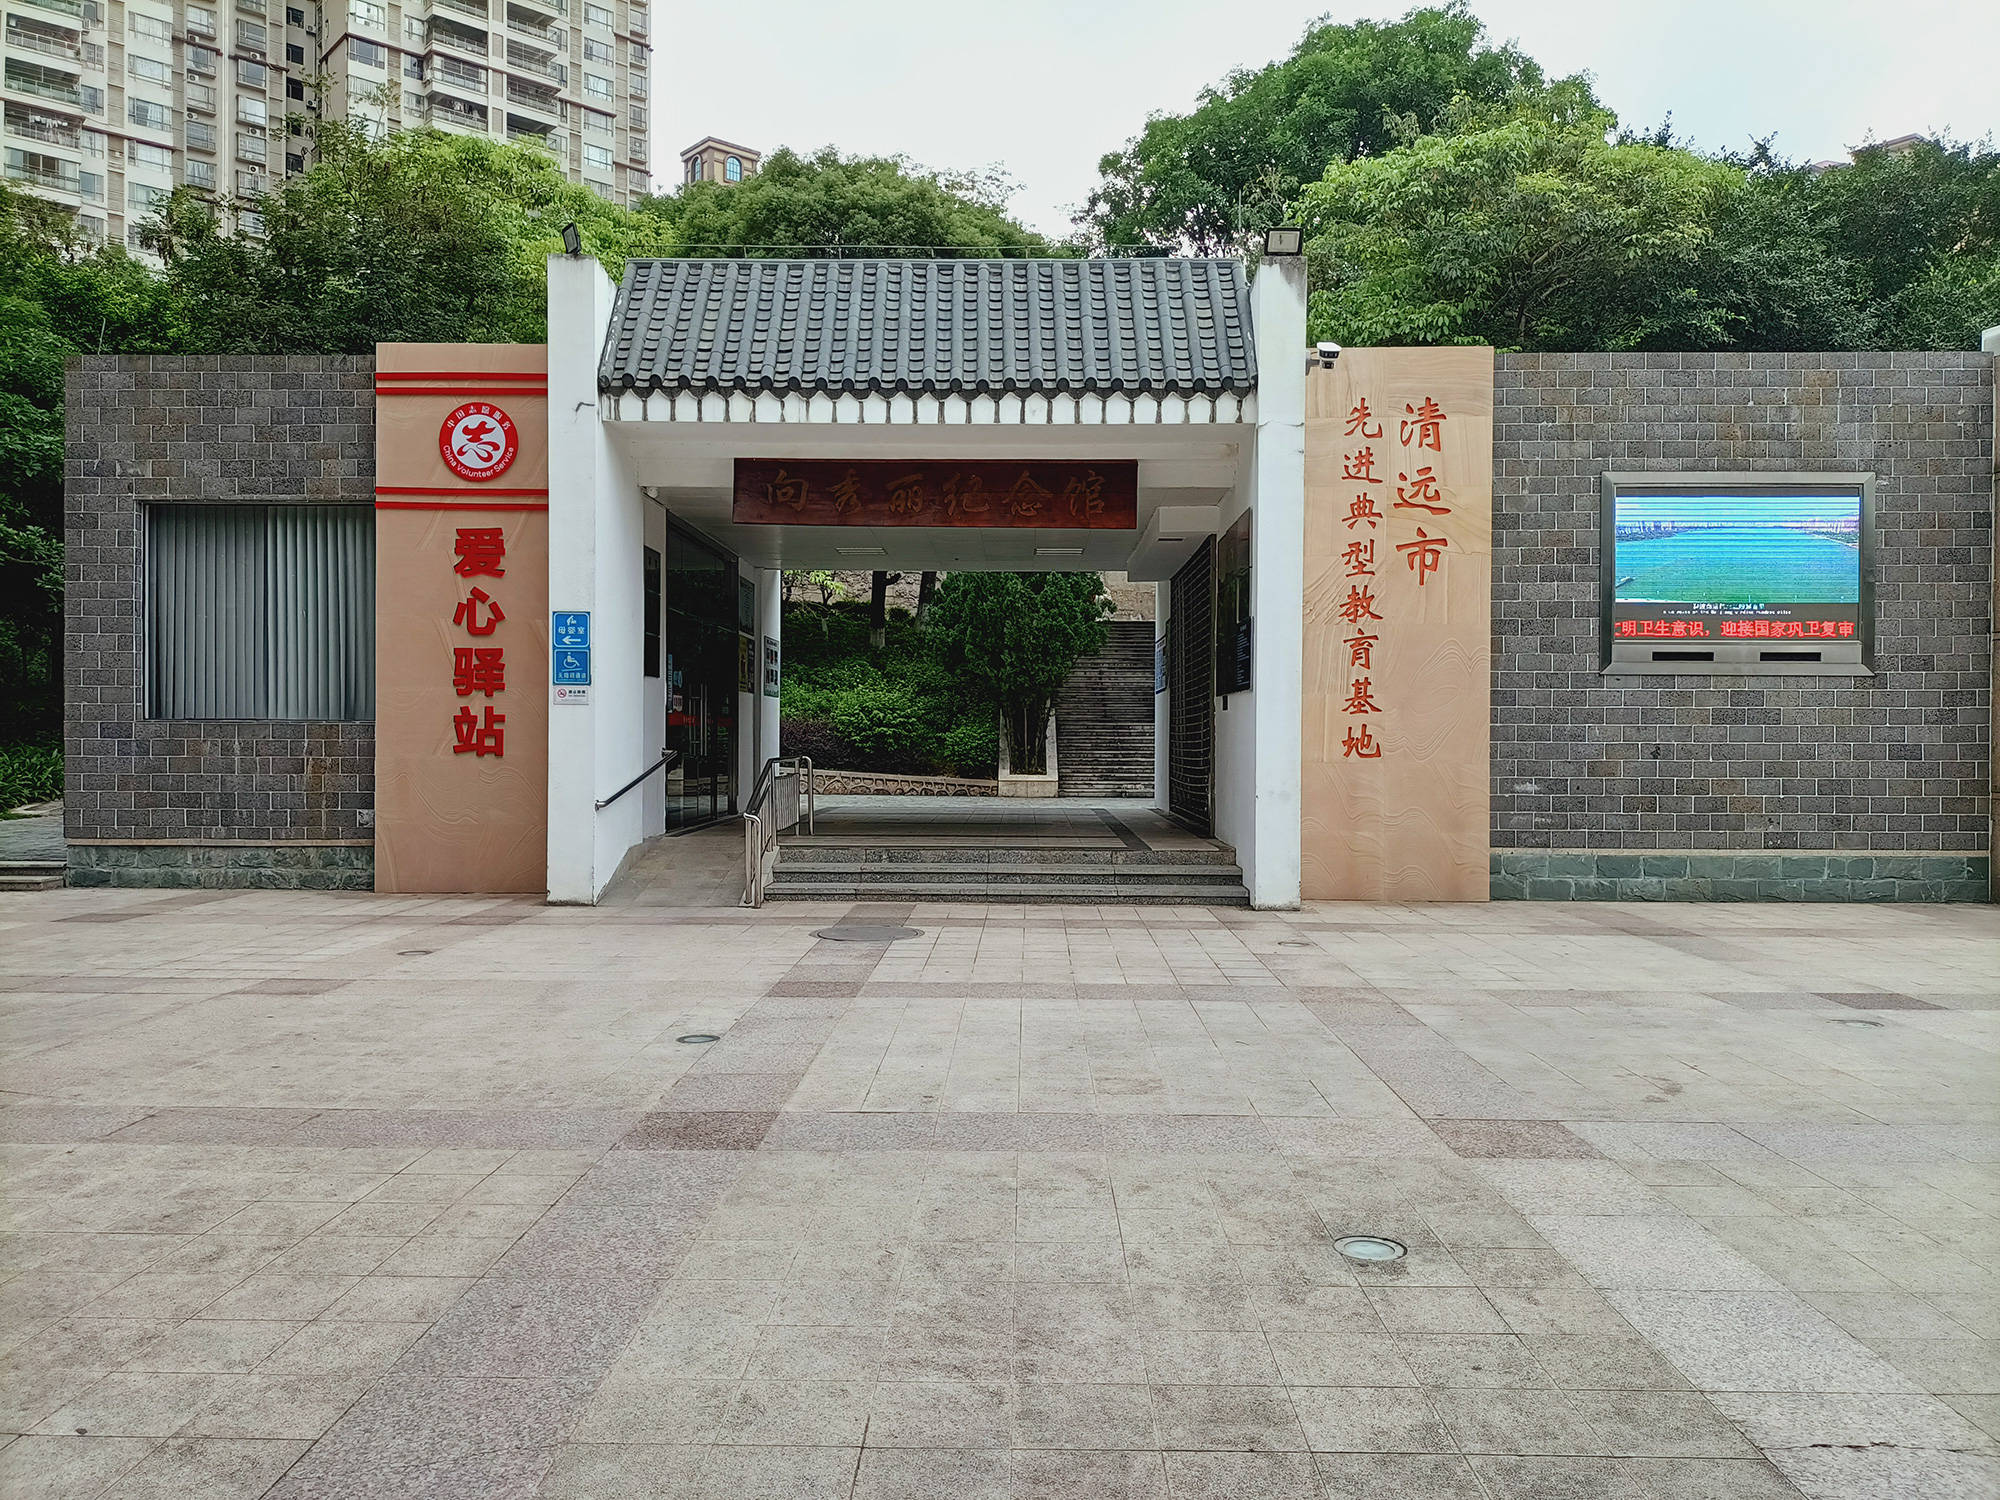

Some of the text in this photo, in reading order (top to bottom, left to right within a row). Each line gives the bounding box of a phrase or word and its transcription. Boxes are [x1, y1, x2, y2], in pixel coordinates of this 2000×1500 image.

[443, 444, 514, 479] China Volunteer Service
[766, 468, 1106, 521] 向秀丽纪念馆
[1393, 396, 1452, 586] 清远市
[453, 527, 506, 759] 爱心驿站
[1339, 397, 1384, 760] 先进典型教育基地
